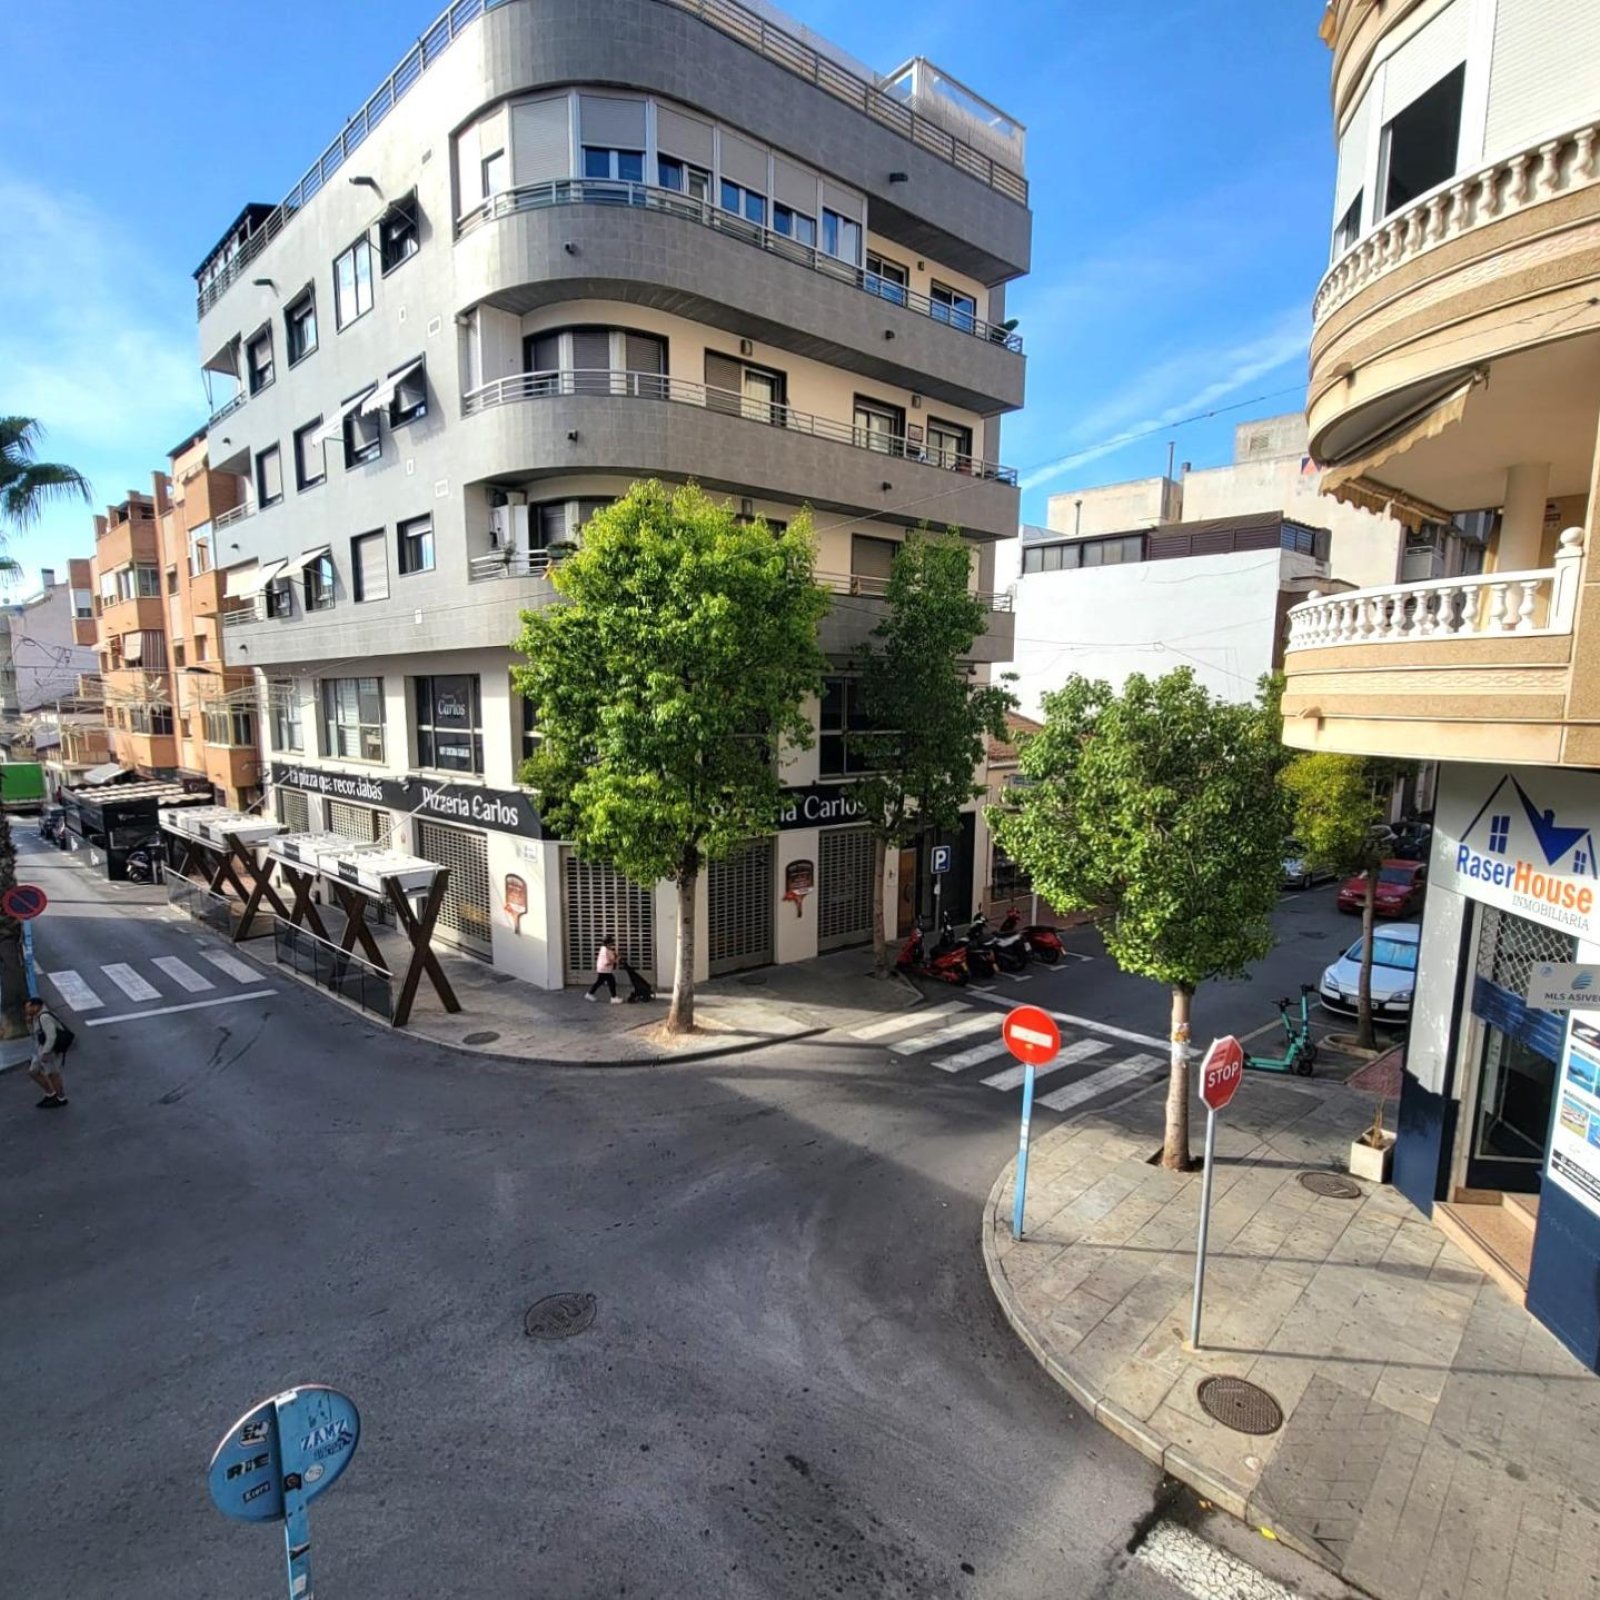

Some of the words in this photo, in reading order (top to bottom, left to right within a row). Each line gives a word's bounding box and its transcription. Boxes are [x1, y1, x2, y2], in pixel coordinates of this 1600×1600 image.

[438, 699, 466, 716] Carlos
[299, 769, 318, 790] pizza
[422, 786, 470, 817] Pizzeria
[472, 795, 519, 827] Carlos
[804, 795, 868, 820] Carlos
[935, 850, 947, 870] P
[1456, 844, 1593, 914] RaserHouse
[1512, 894, 1589, 931] INMOBILIARIA
[1544, 992, 1566, 1001] MLS
[1207, 1061, 1239, 1088] STOP
